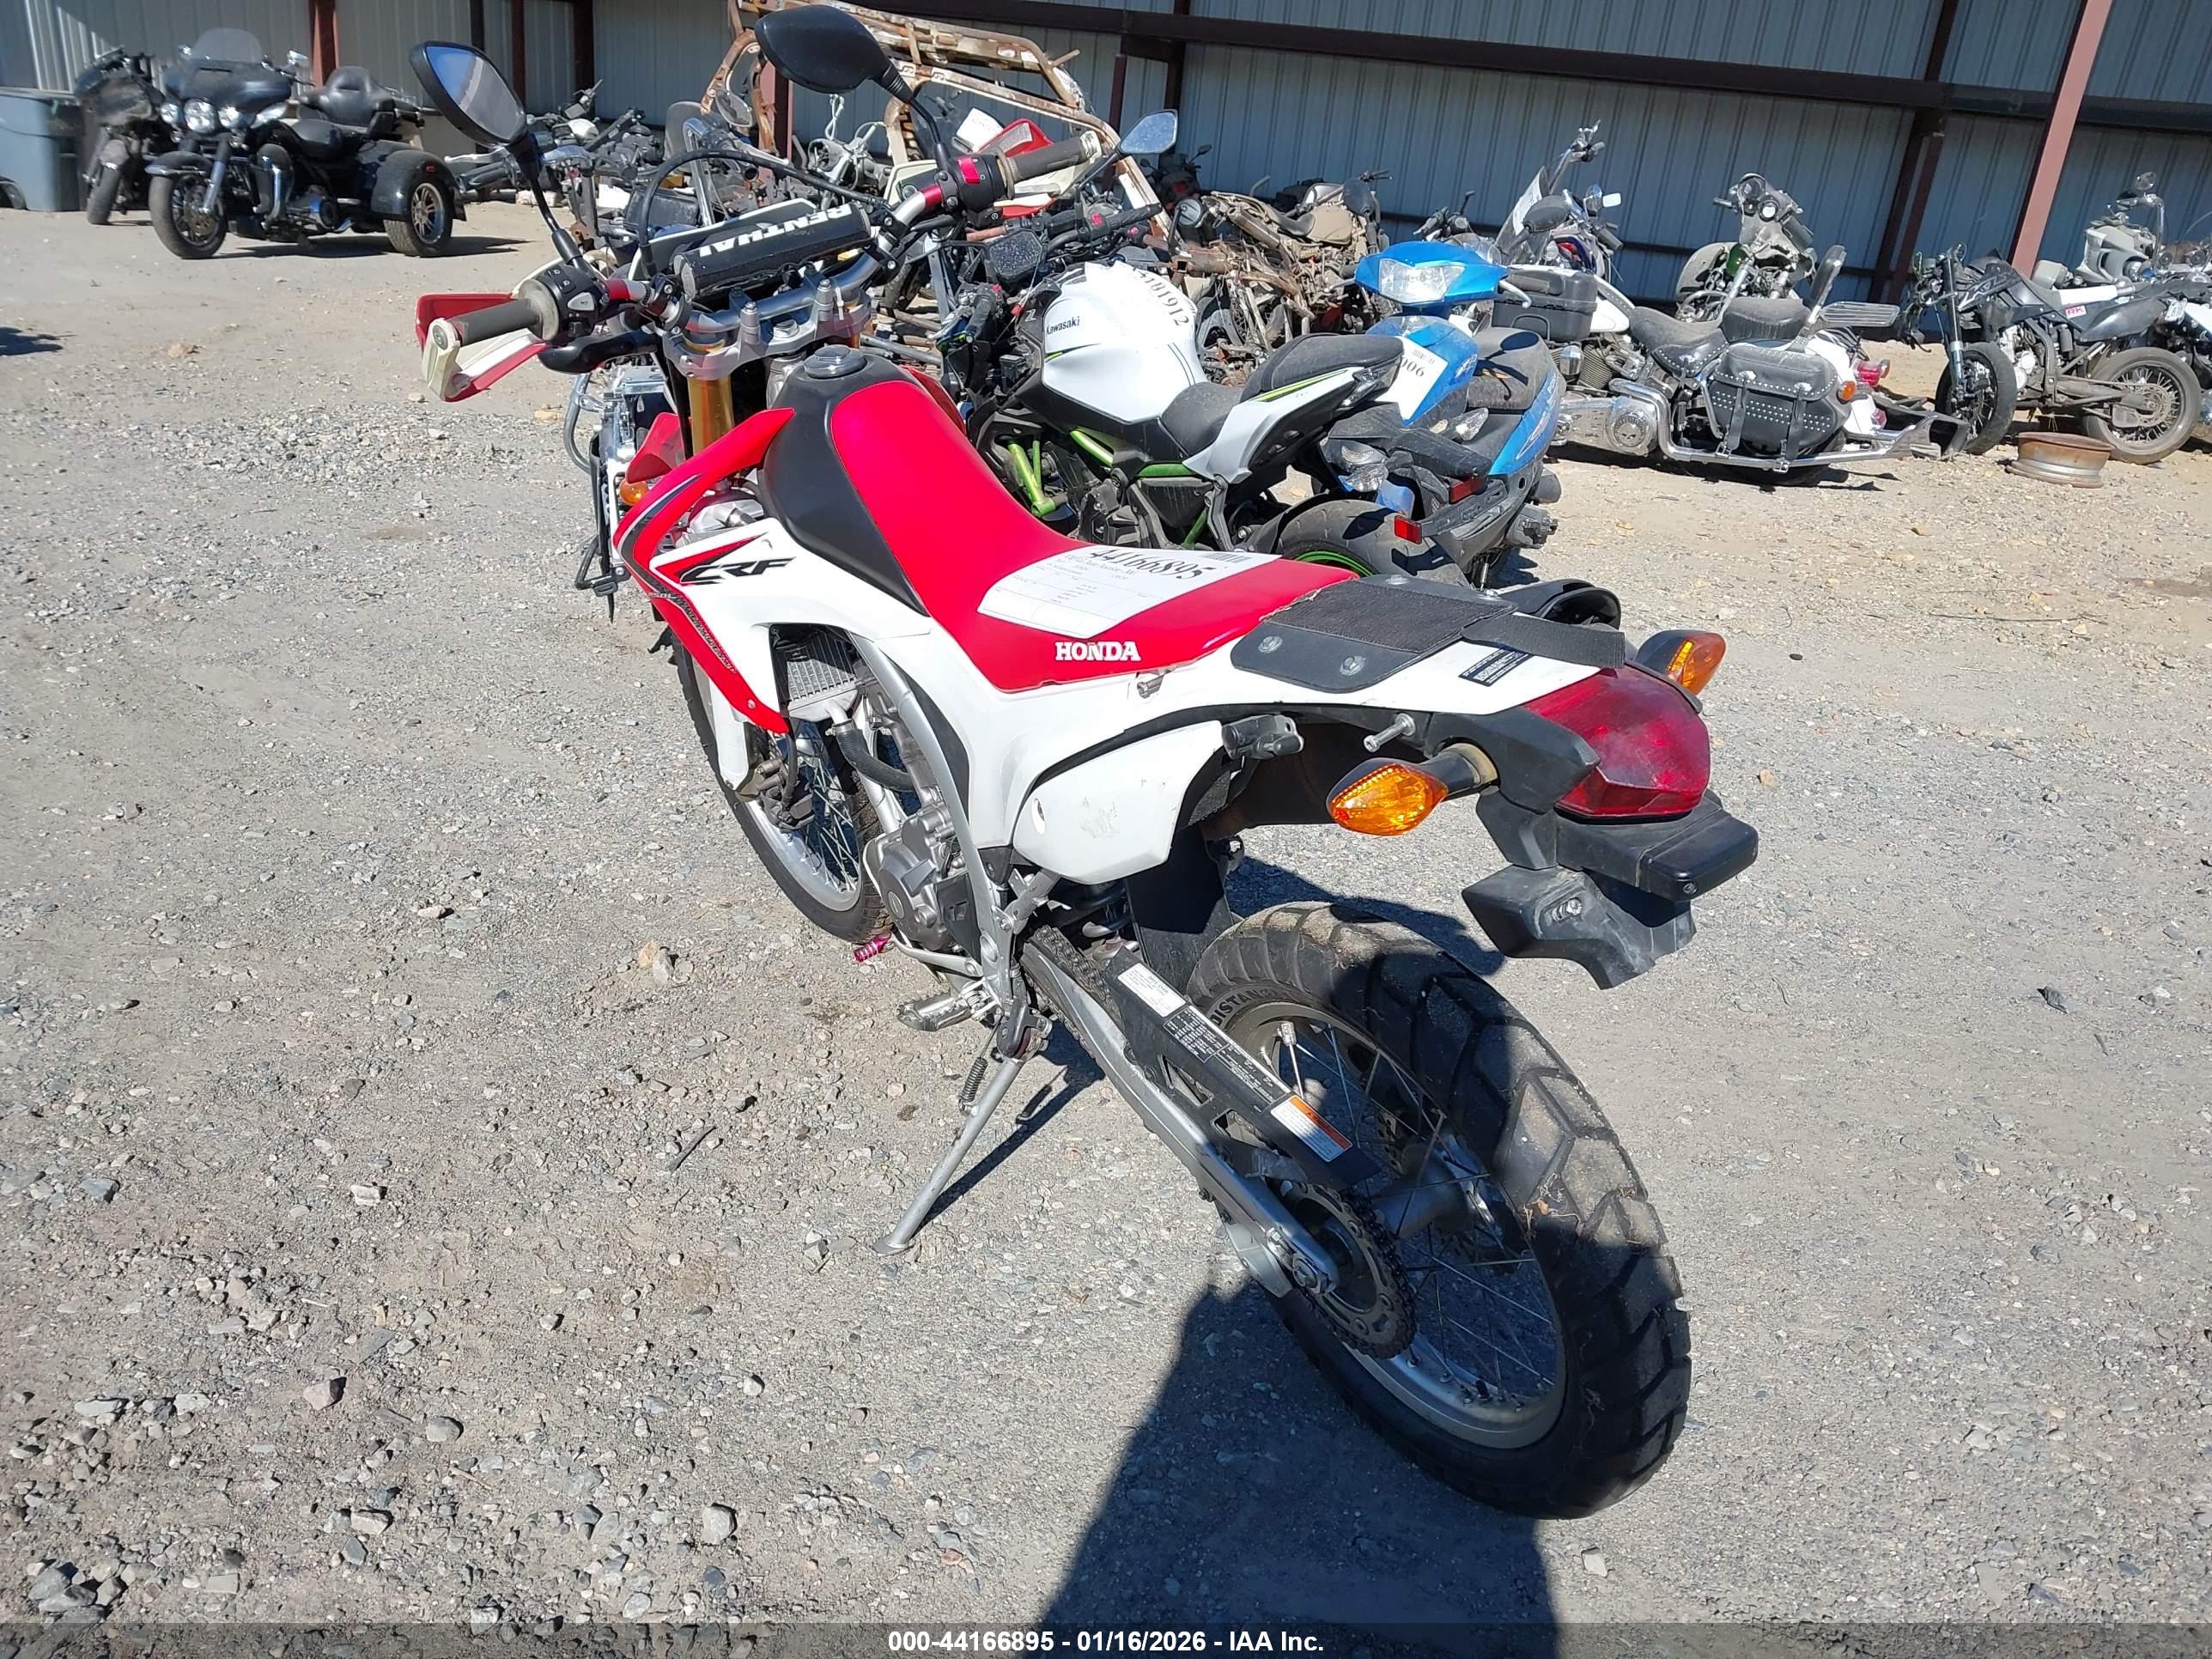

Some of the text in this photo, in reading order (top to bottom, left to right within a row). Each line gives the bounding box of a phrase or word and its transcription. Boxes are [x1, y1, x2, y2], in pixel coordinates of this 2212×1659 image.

[2066, 307, 2085, 317] RK
[1045, 315, 1080, 336] Kawasaki
[679, 556, 797, 586] CRF
[1088, 548, 1218, 580] 44166895
[1054, 641, 1141, 662] HONDA
